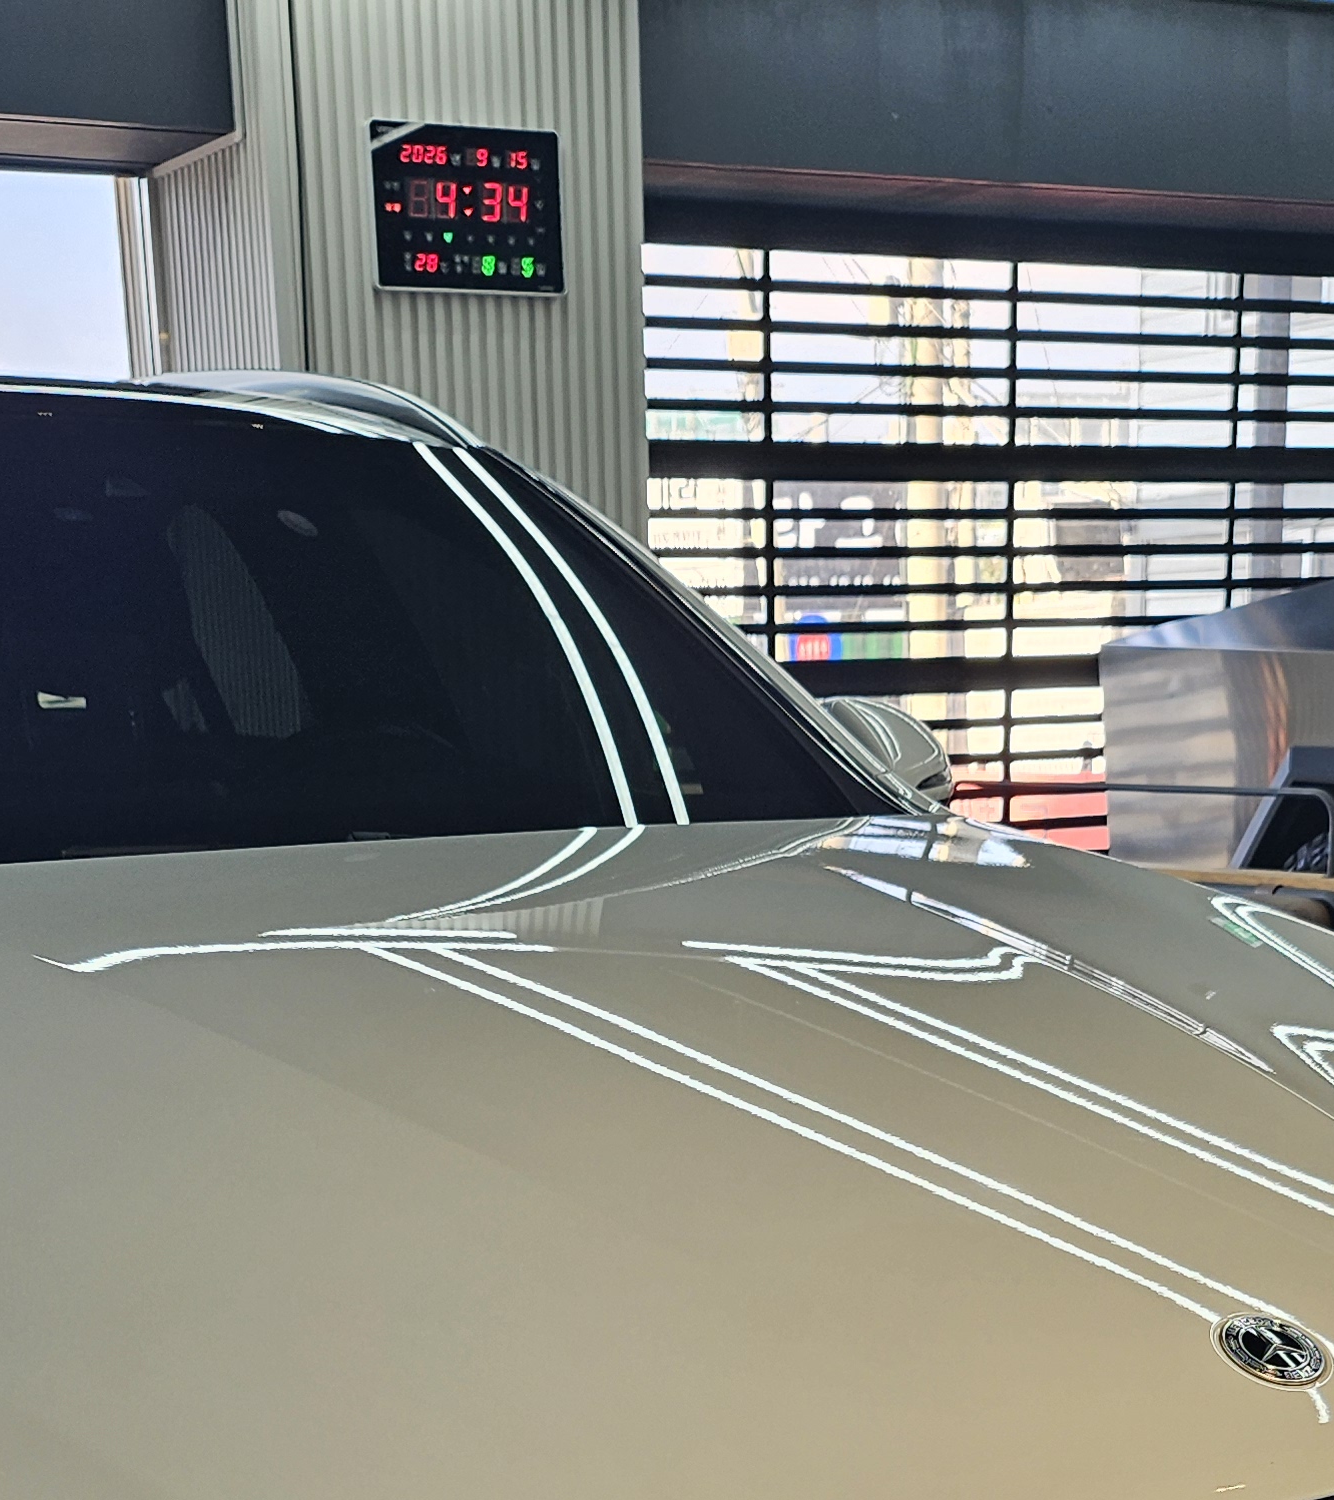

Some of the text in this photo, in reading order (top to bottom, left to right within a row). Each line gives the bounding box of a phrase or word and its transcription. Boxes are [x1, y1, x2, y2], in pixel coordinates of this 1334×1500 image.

[399, 144, 528, 170] 2026 9 15
